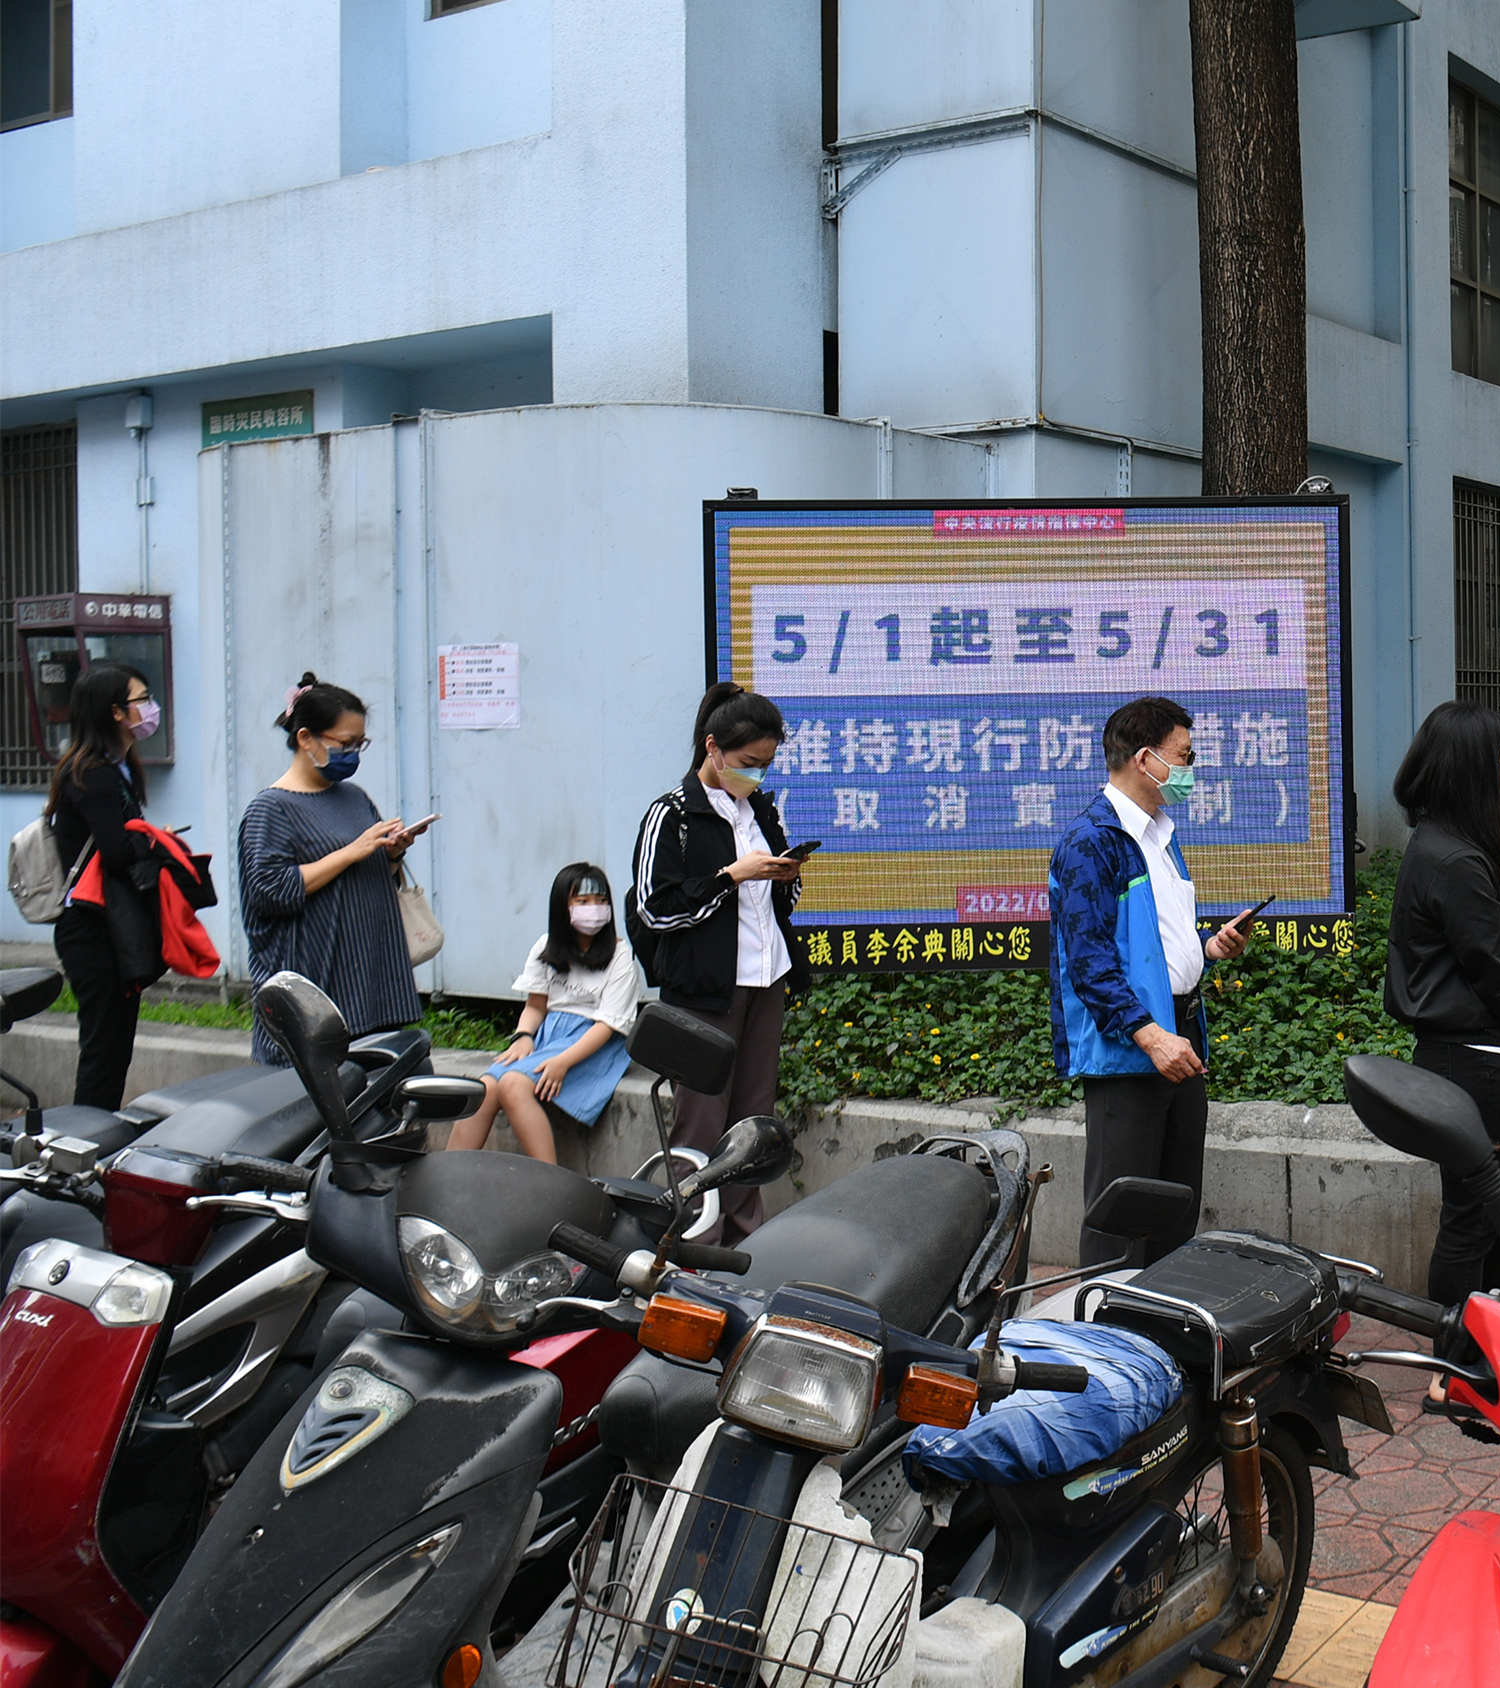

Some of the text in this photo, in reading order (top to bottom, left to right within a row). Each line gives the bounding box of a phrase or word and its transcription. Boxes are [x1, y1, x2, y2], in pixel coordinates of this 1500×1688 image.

[209, 405, 304, 434] 臨時災民收容所
[944, 514, 1115, 530] 中央流行疫情指揮中心
[102, 602, 163, 620] 中華電信
[771, 606, 1280, 674] 5/1起至5/31
[772, 711, 1290, 776] 維持現行防措施
[797, 925, 1031, 966] 議員李余典關心您
[1141, 1424, 1188, 1466] SANYANG
